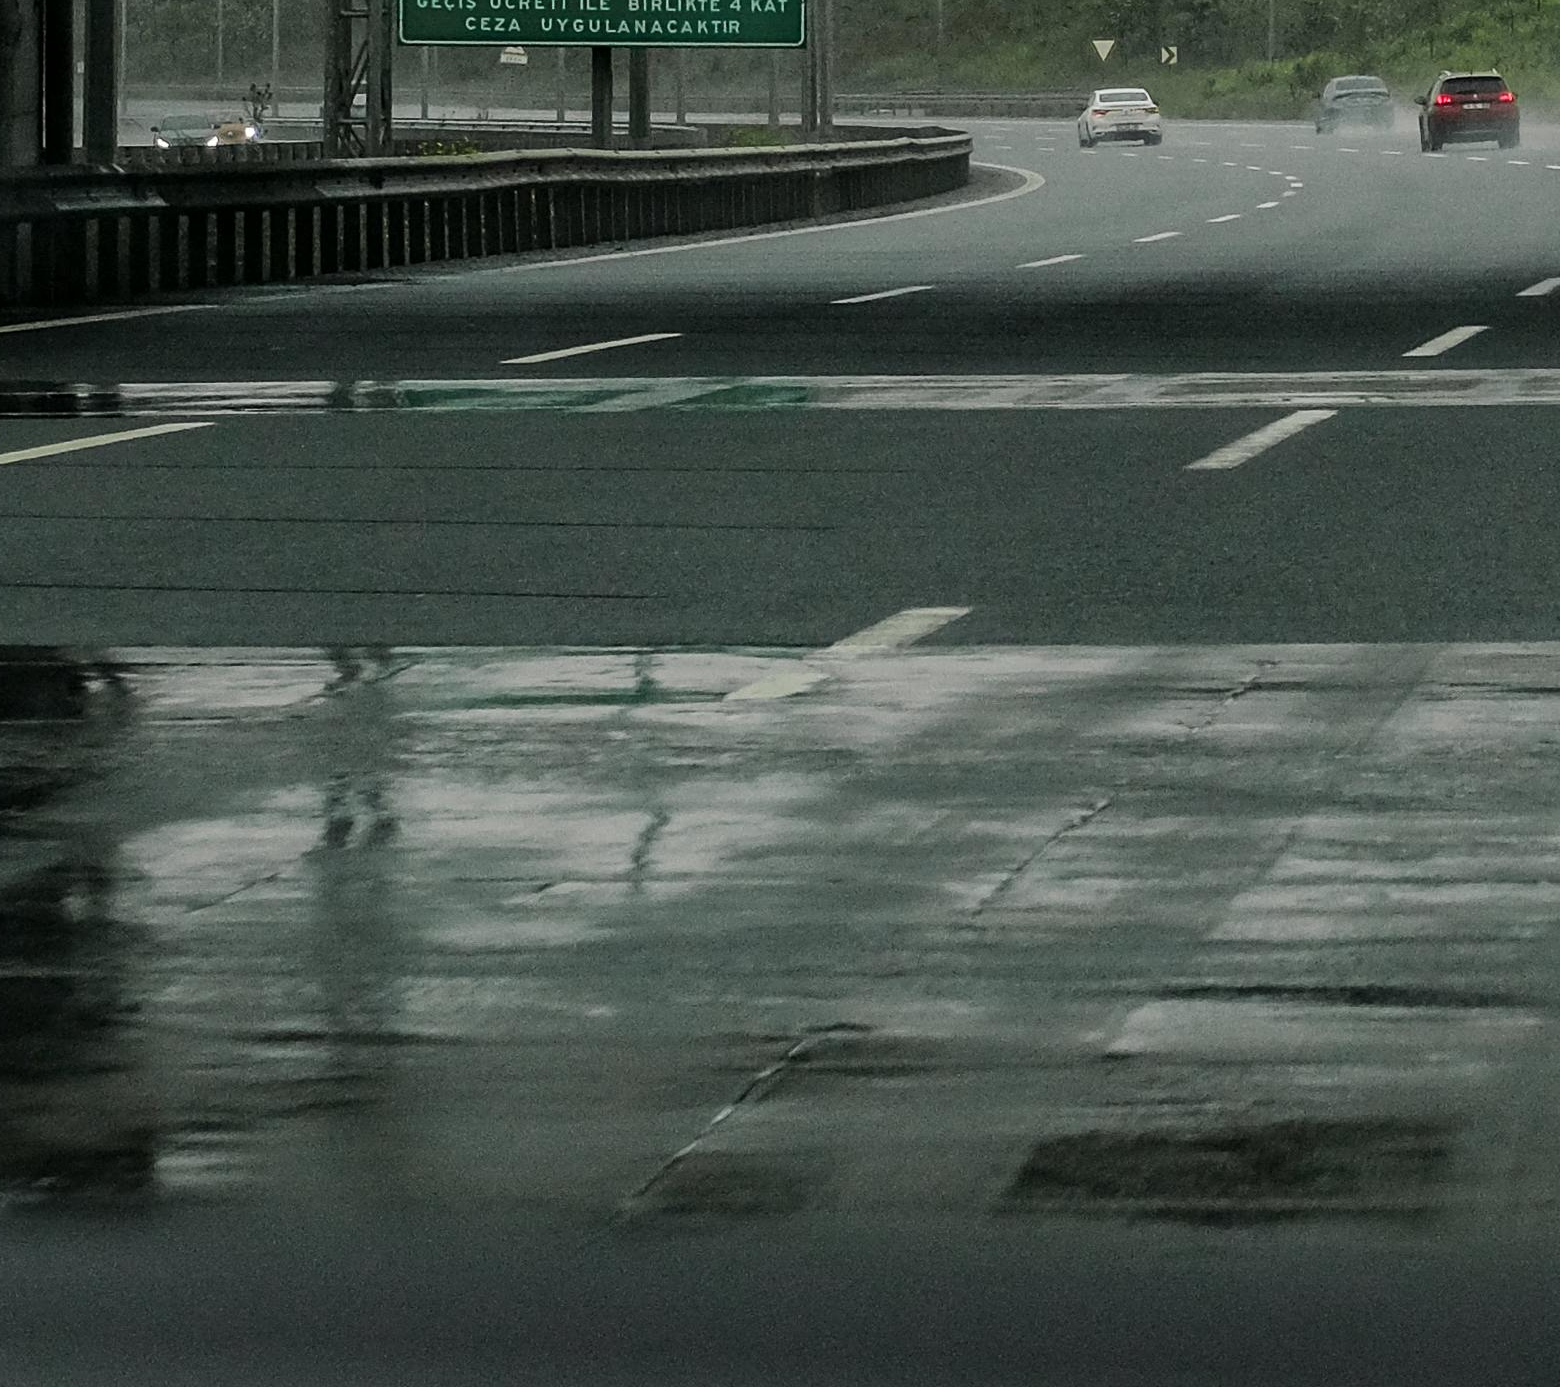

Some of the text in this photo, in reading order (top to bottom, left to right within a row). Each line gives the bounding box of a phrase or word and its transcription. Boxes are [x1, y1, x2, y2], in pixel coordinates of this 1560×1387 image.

[730, 0, 741, 11] 4
[751, 0, 787, 12] KAT
[466, 17, 739, 33] CEZA UYGULANACAKTIR
